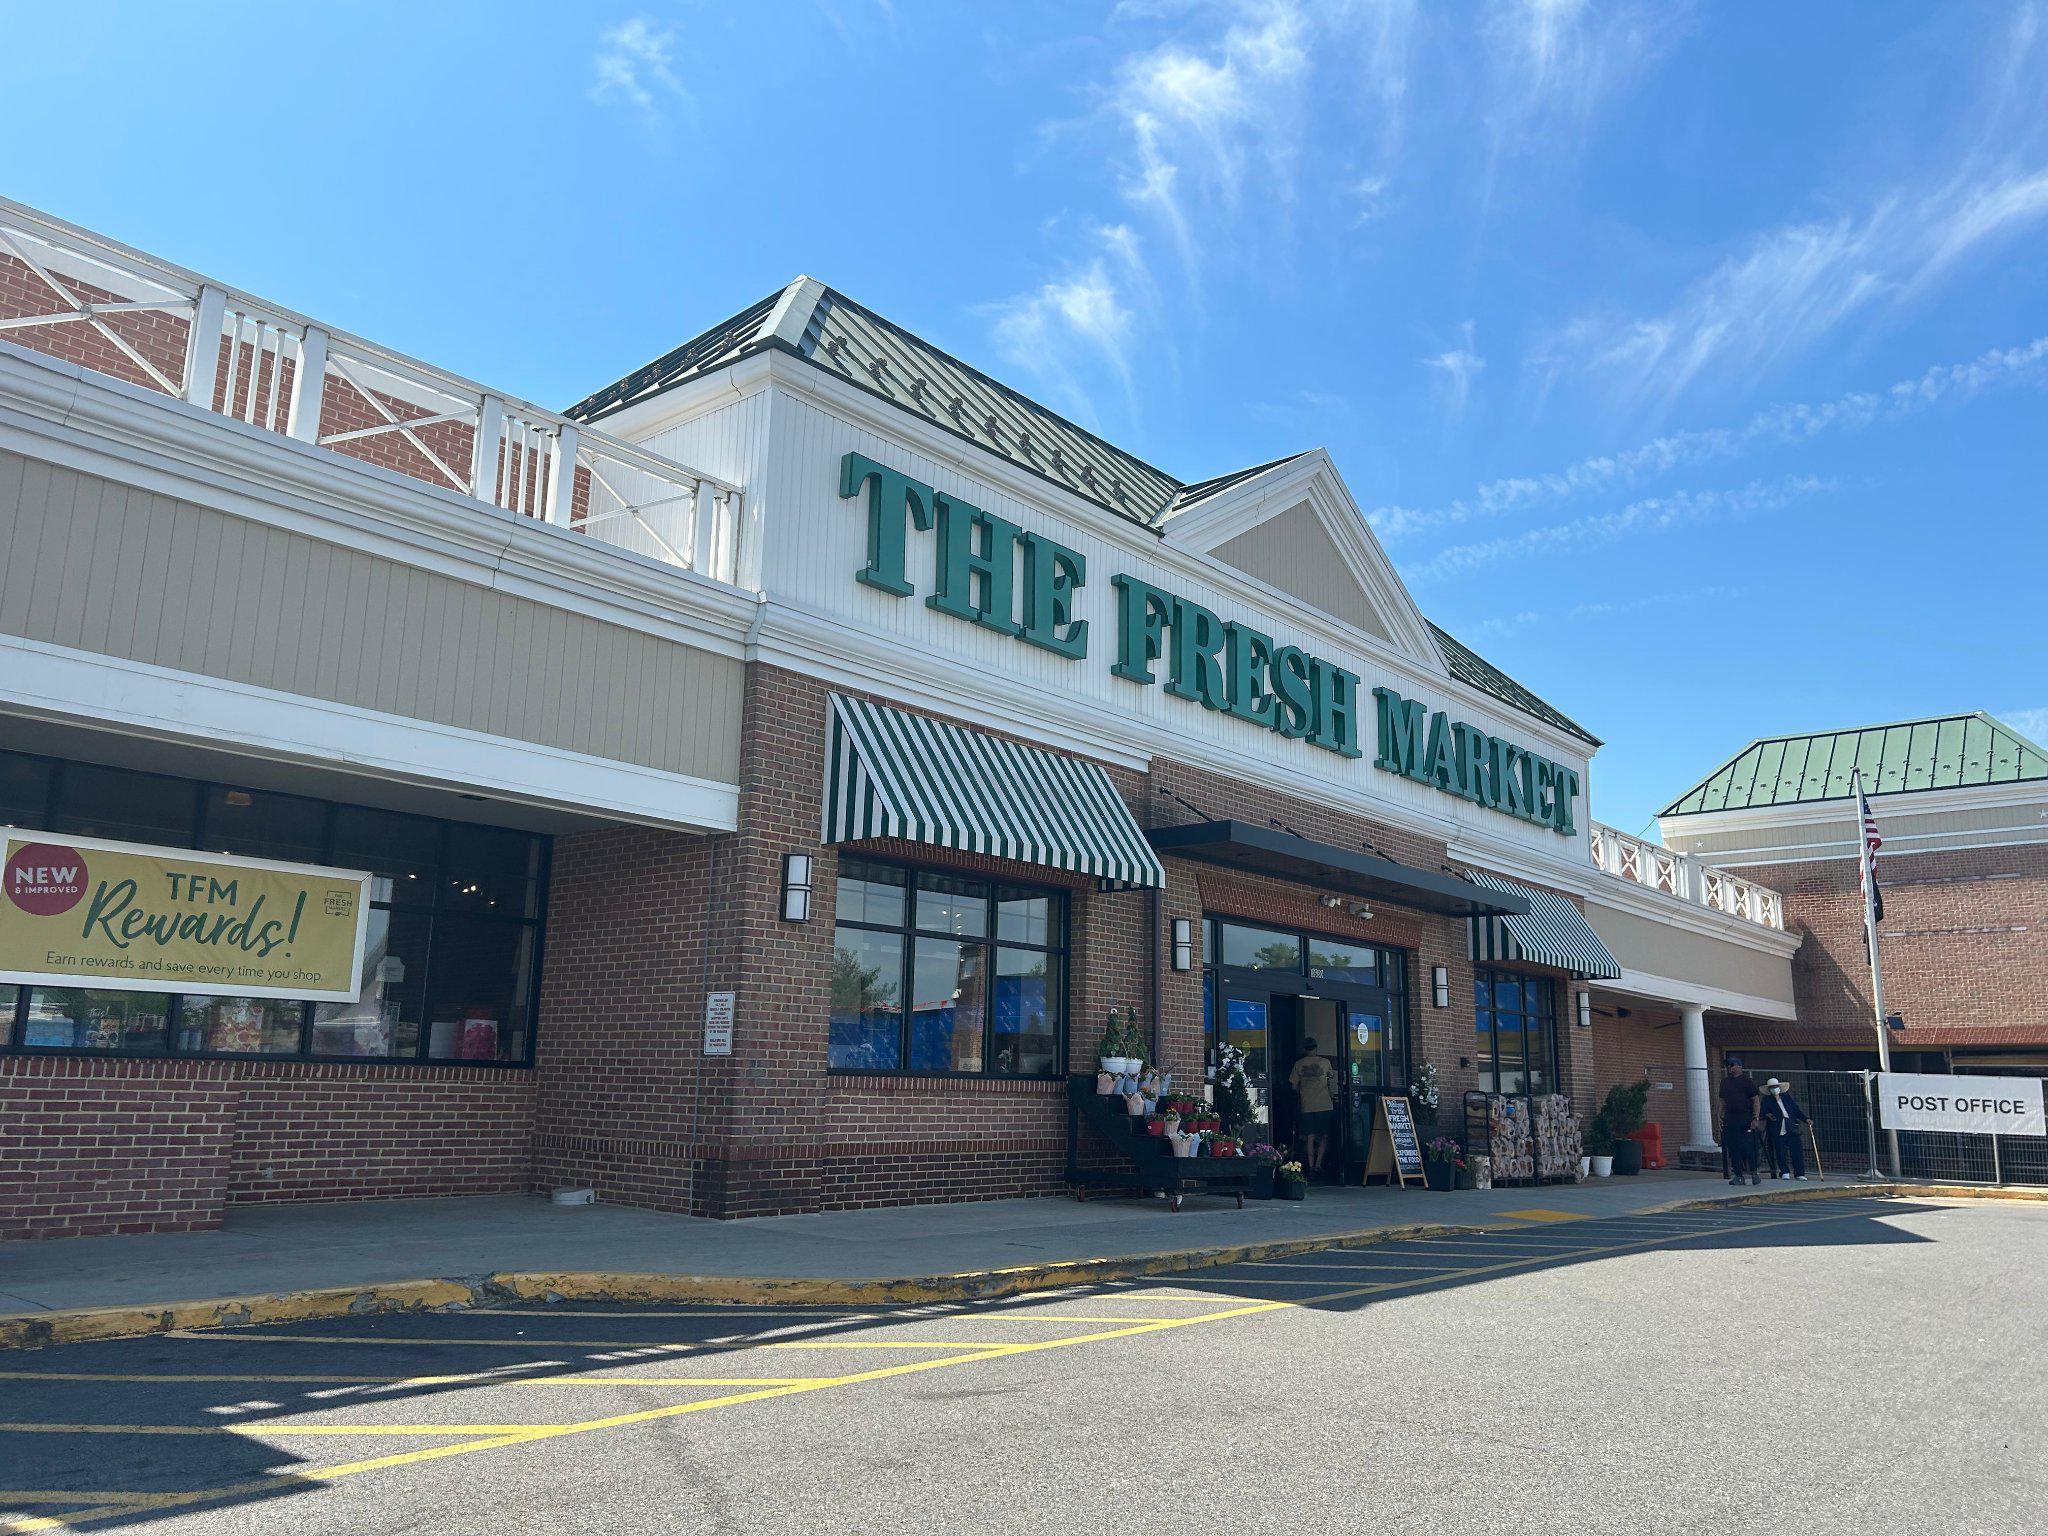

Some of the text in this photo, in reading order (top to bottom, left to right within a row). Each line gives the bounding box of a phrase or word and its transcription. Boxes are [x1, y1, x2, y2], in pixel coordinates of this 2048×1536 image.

[839, 451, 1579, 836] THE FRESH MARKET
[15, 866, 78, 884] NEW
[15, 886, 78, 894] & IMPROVED
[166, 872, 239, 906] TFM
[324, 897, 352, 907] FRESH
[82, 878, 307, 958] Rewards!
[46, 950, 76, 966] Earn
[81, 955, 134, 969] rewards
[138, 958, 162, 971] and
[166, 962, 194, 972] save
[198, 963, 234, 978] every
[238, 965, 264, 978] time
[268, 968, 290, 981] you
[1897, 1095, 2026, 1115] POST OFFICE
[1388, 1114, 1409, 1122] FRESH
